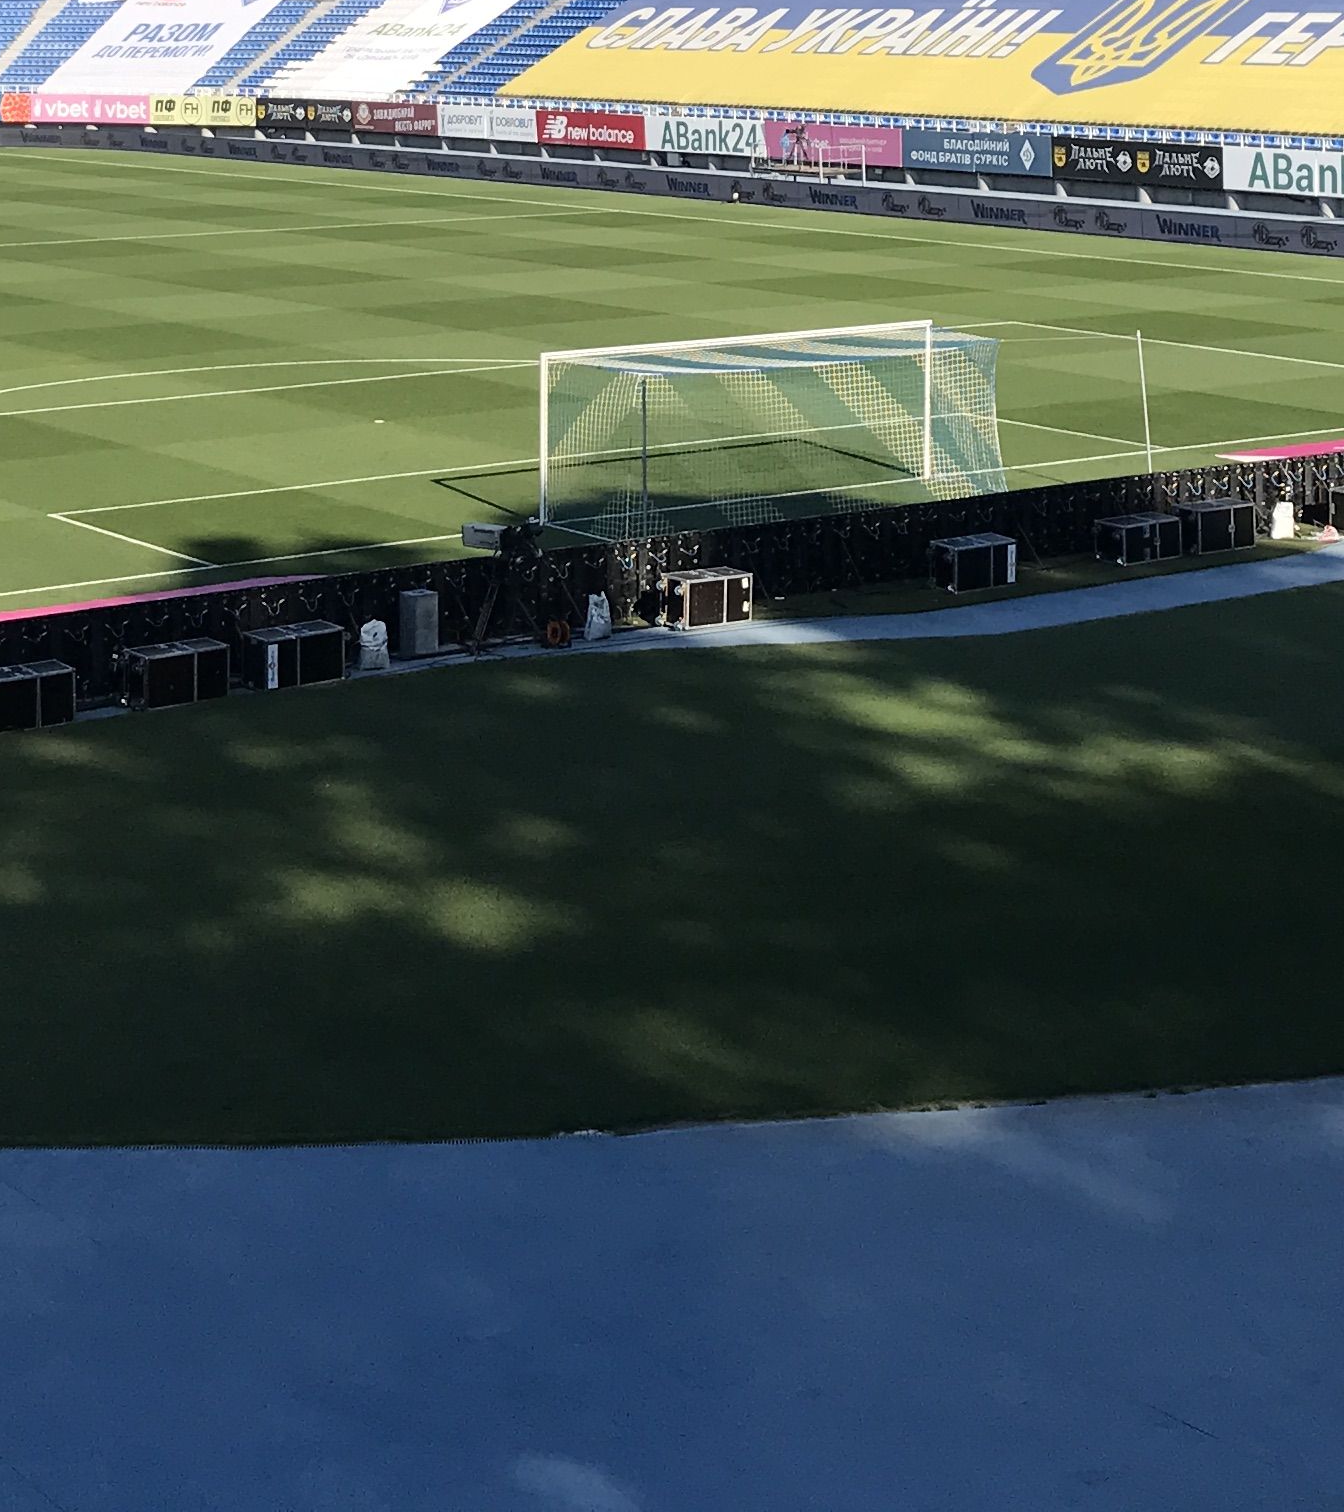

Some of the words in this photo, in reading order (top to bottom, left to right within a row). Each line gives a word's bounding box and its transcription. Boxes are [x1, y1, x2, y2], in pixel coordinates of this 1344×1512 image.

[122, 23, 226, 43] РАЗОМ
[367, 22, 468, 37] ABank24
[585, 6, 789, 52] СЛАВА
[91, 45, 124, 59] ДО
[121, 44, 214, 59] ПЕРЕМОГИ!
[46, 99, 89, 118] vbet
[105, 100, 146, 119] vbet
[155, 99, 176, 112] ПФ
[212, 100, 231, 113] ПФ
[447, 113, 483, 126] ДОБРОБУТ
[495, 116, 533, 128] DOBROBUT
[568, 126, 588, 141] new
[590, 127, 634, 144] balance
[661, 119, 758, 154] ABank24
[943, 137, 1010, 153] БЛАГОДІЙНИЙ
[1069, 144, 1116, 161] ПАЛЬНЕ
[910, 150, 937, 164] ФОНД
[938, 151, 971, 165] БРАТІВ
[974, 154, 1009, 166] СУРКІС
[1075, 159, 1109, 174] ЛЮТІ
[1153, 149, 1203, 167] ПАЛЬНЕ
[1159, 164, 1197, 180] ЛЮТІ
[665, 175, 714, 197] WINNER
[808, 186, 859, 210] WINNER
[971, 199, 1028, 225] WINNER
[1156, 214, 1222, 243] WINNER
